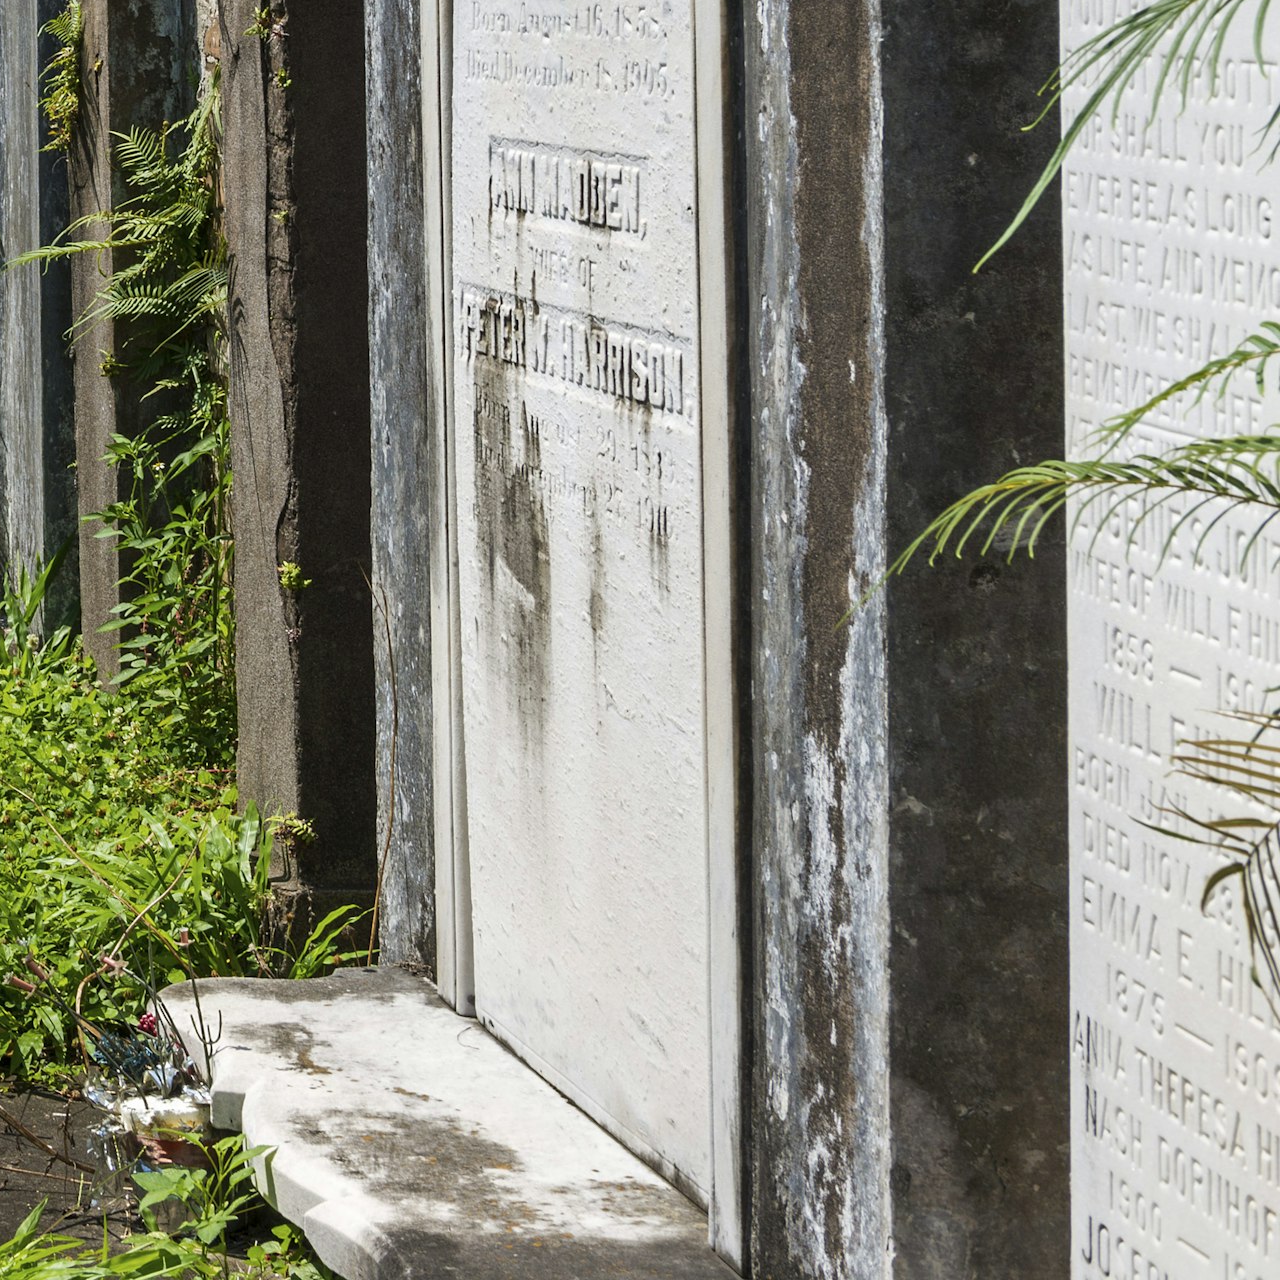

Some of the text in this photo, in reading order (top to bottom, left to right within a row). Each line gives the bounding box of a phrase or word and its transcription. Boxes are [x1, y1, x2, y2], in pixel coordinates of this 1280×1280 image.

[472, 1, 511, 34] Born
[518, 1, 579, 41] August
[466, 49, 501, 82] Died
[503, 51, 590, 87] December
[1110, 113, 1197, 161] SHALL
[1195, 120, 1245, 167] YOU
[1067, 170, 1122, 218] EVER
[1164, 183, 1197, 229] AS
[1203, 186, 1272, 239] LONG
[1066, 230, 1094, 273] AS
[1161, 246, 1204, 294] AND
[460, 292, 527, 369] PETER
[1132, 304, 1168, 352] WE
[1127, 566, 1154, 618] OF
[1160, 578, 1221, 643] WILL
[1092, 680, 1162, 760] WILL
[1074, 744, 1131, 810] BORN
[1082, 811, 1131, 873] DIED
[1082, 874, 1163, 972] EMMA
[1176, 927, 1205, 992] E.
[1105, 960, 1165, 1036] 1875
[1073, 1009, 1127, 1088] ANNA
[1134, 1045, 1246, 1167] THERESA
[1086, 1083, 1143, 1169] NASH
[1082, 1215, 1170, 1280] JOSE
